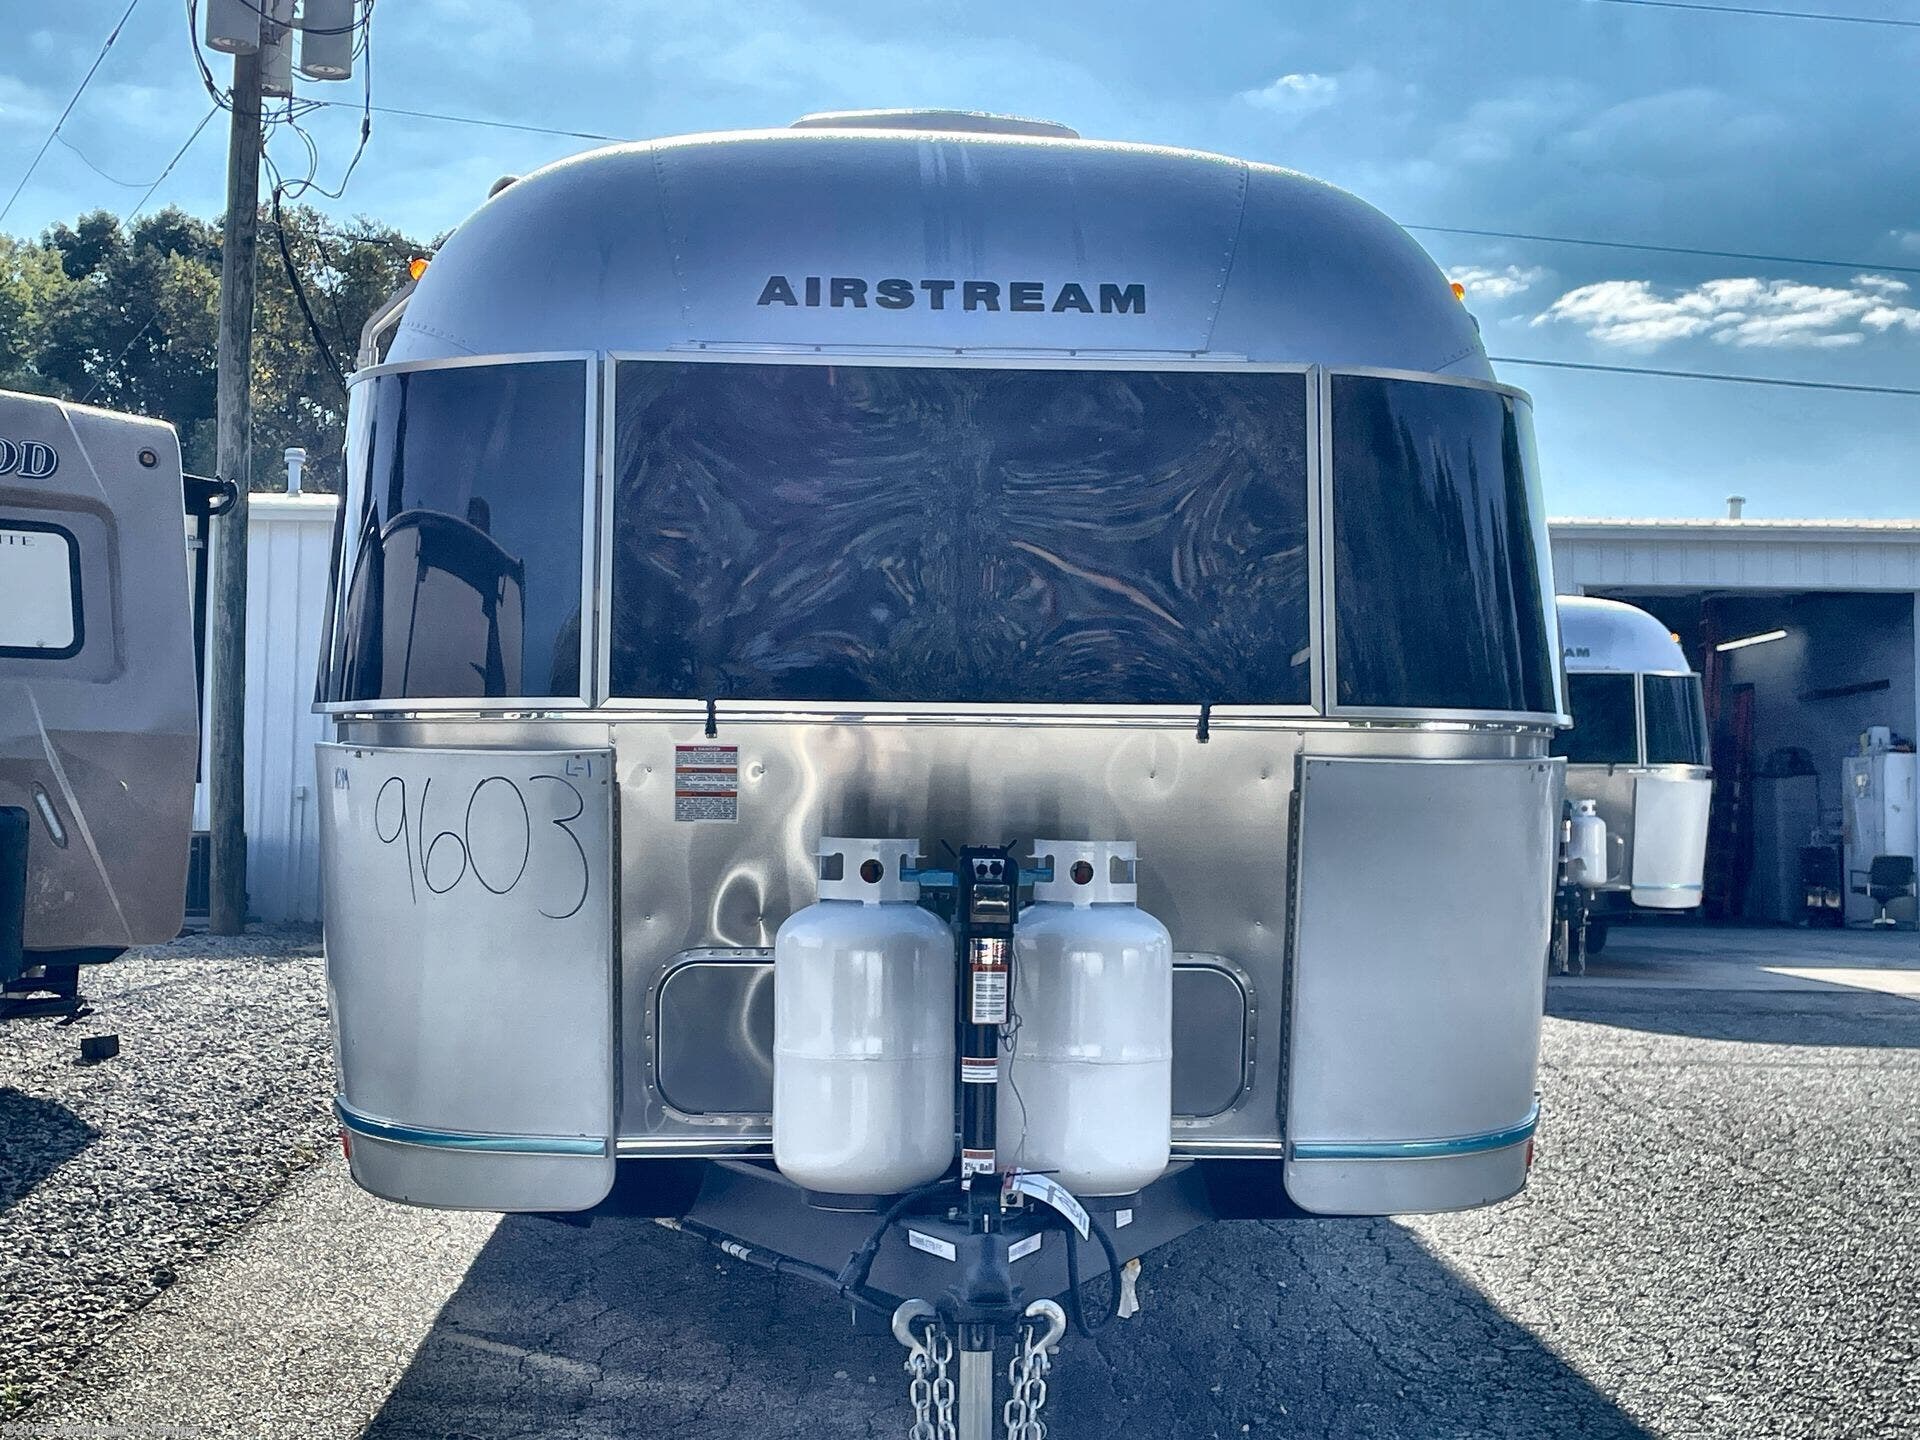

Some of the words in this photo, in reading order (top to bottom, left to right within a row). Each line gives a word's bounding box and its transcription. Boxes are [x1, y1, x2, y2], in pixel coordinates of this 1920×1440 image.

[757, 275, 1147, 314] AIRSTREAM
[1564, 647, 1591, 658] AM
[374, 775, 590, 920] 9603
